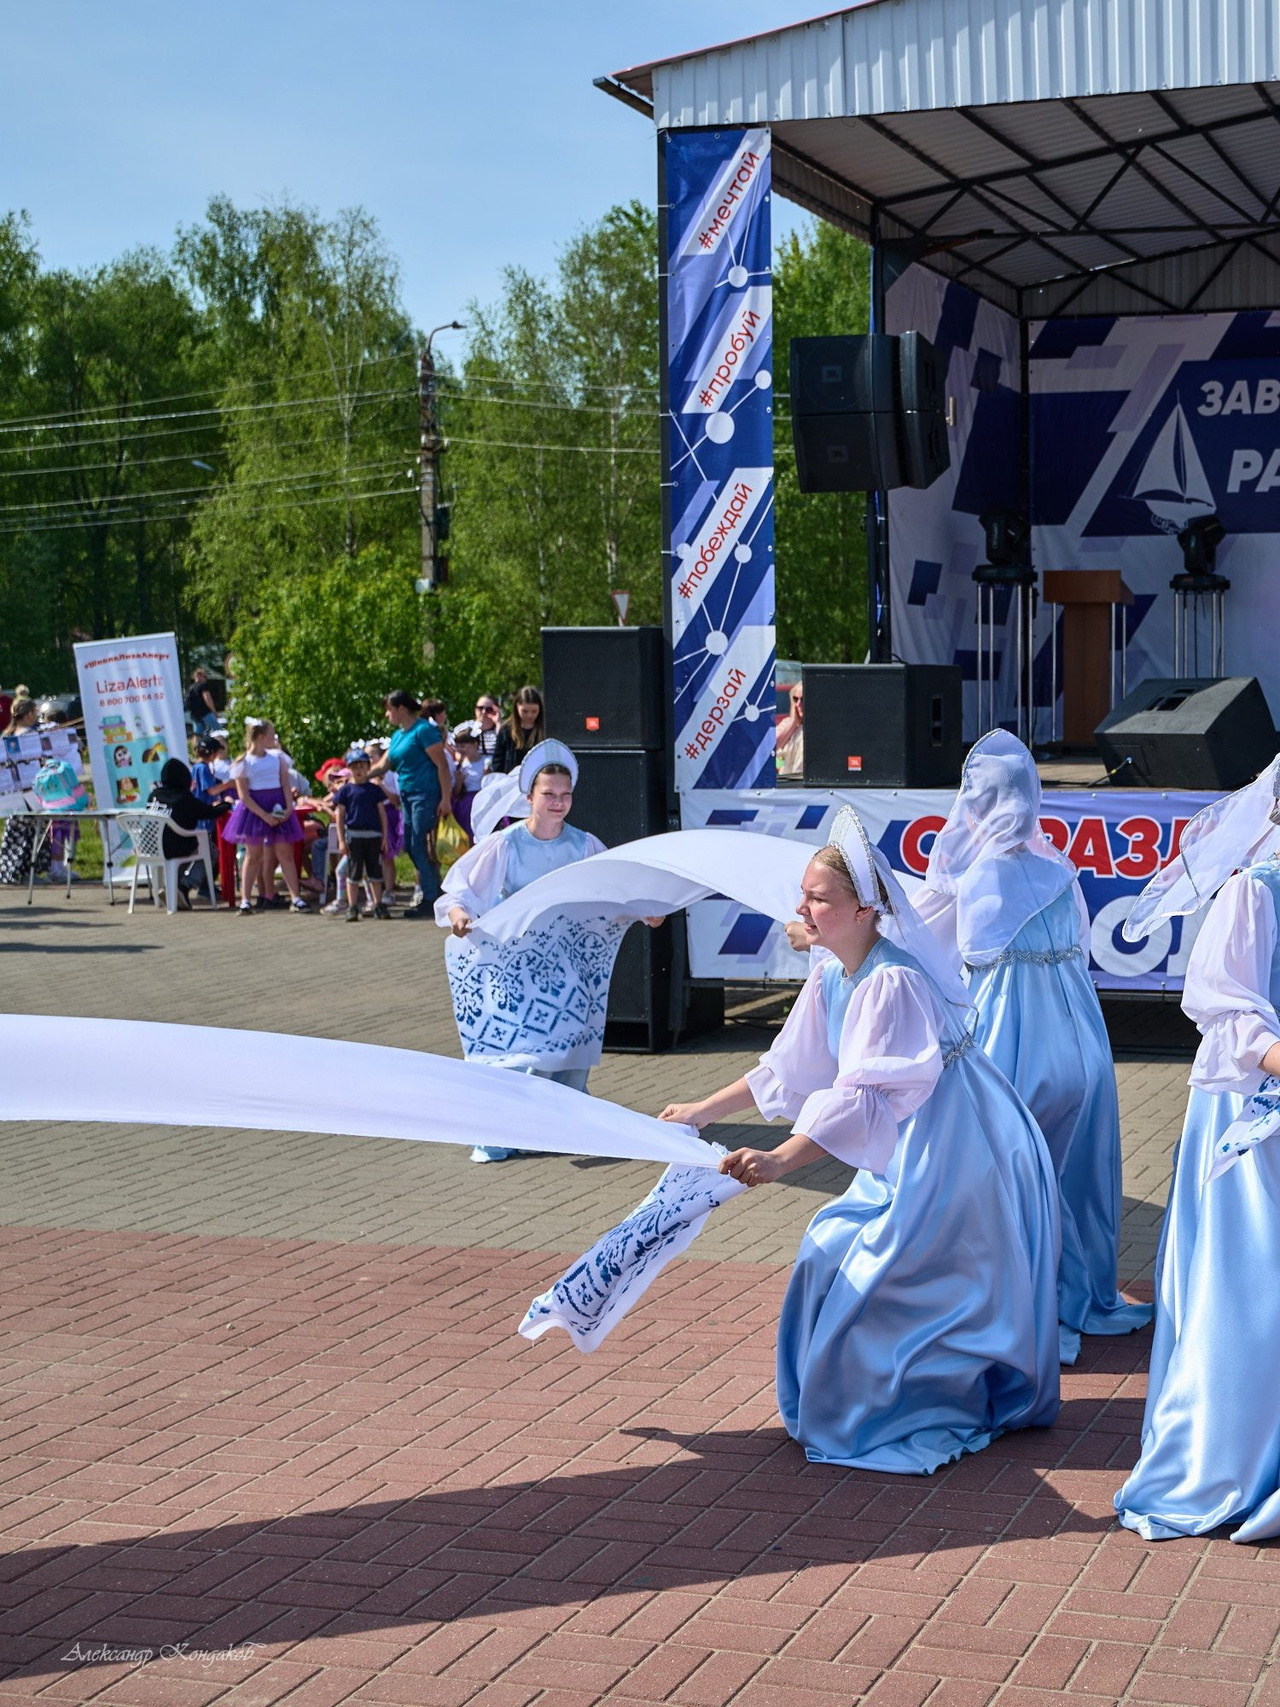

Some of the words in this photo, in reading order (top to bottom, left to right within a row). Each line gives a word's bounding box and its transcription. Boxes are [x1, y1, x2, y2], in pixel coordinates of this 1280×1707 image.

[699, 152, 760, 250] #мечтай
[699, 311, 760, 408] #пробуй
[677, 482, 752, 599] #побеждай
[96, 675, 157, 694] LizaAlert
[684, 668, 747, 760] #дерзай
